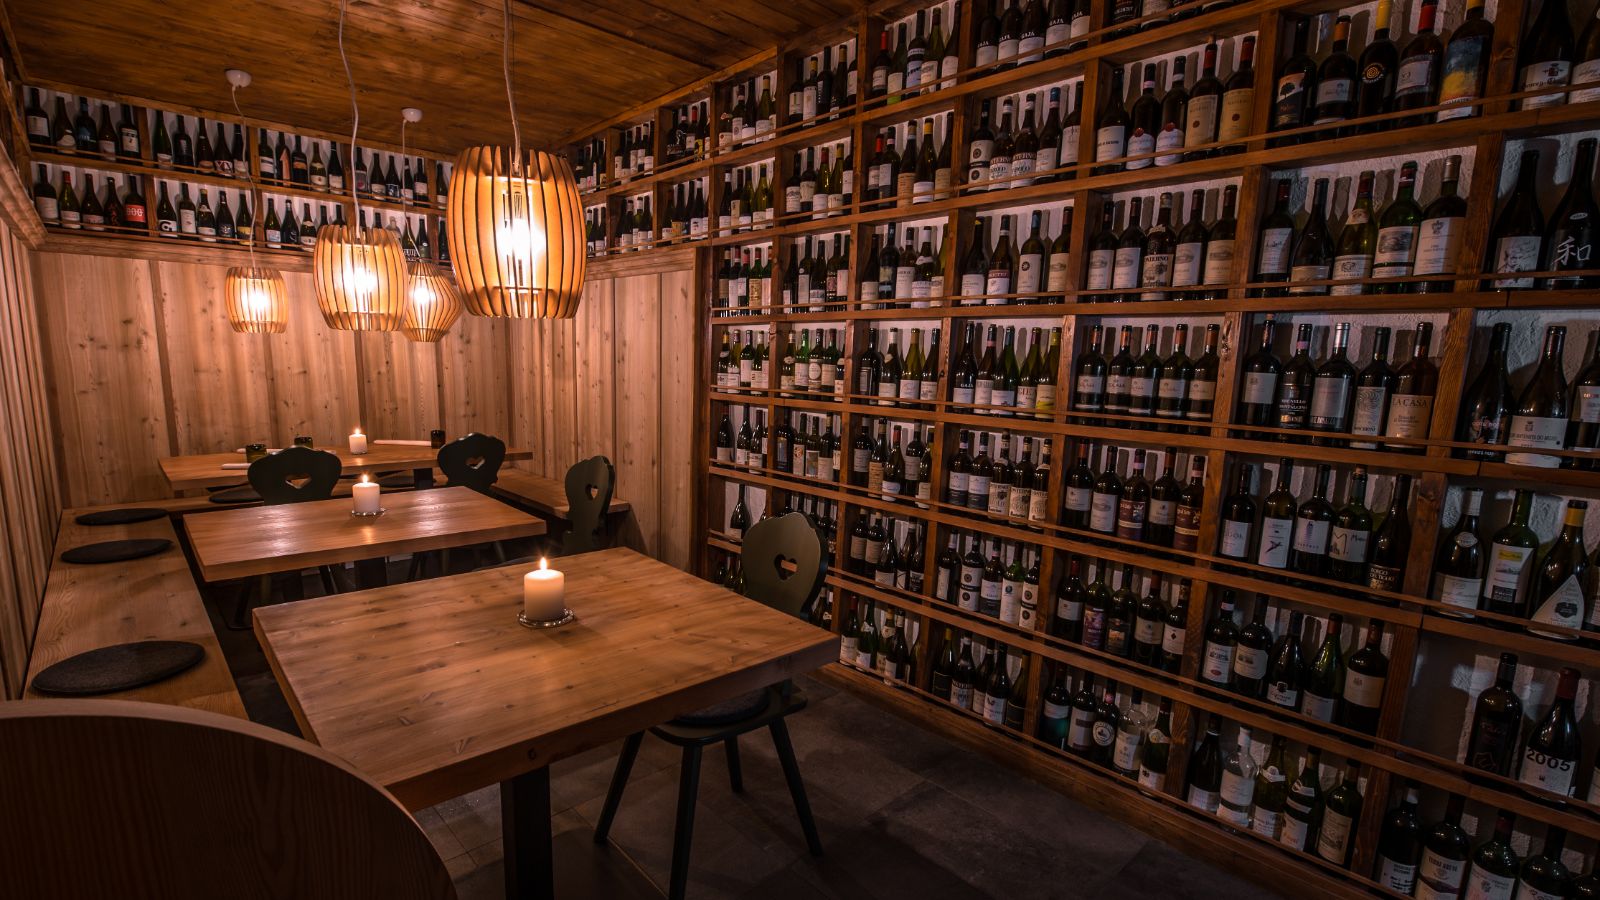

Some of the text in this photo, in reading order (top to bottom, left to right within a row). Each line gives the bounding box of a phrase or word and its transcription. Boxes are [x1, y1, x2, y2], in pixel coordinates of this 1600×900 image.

[1552, 235, 1592, 266] 和
[1403, 399, 1426, 407] CASA
[1526, 748, 1571, 772] 2005
